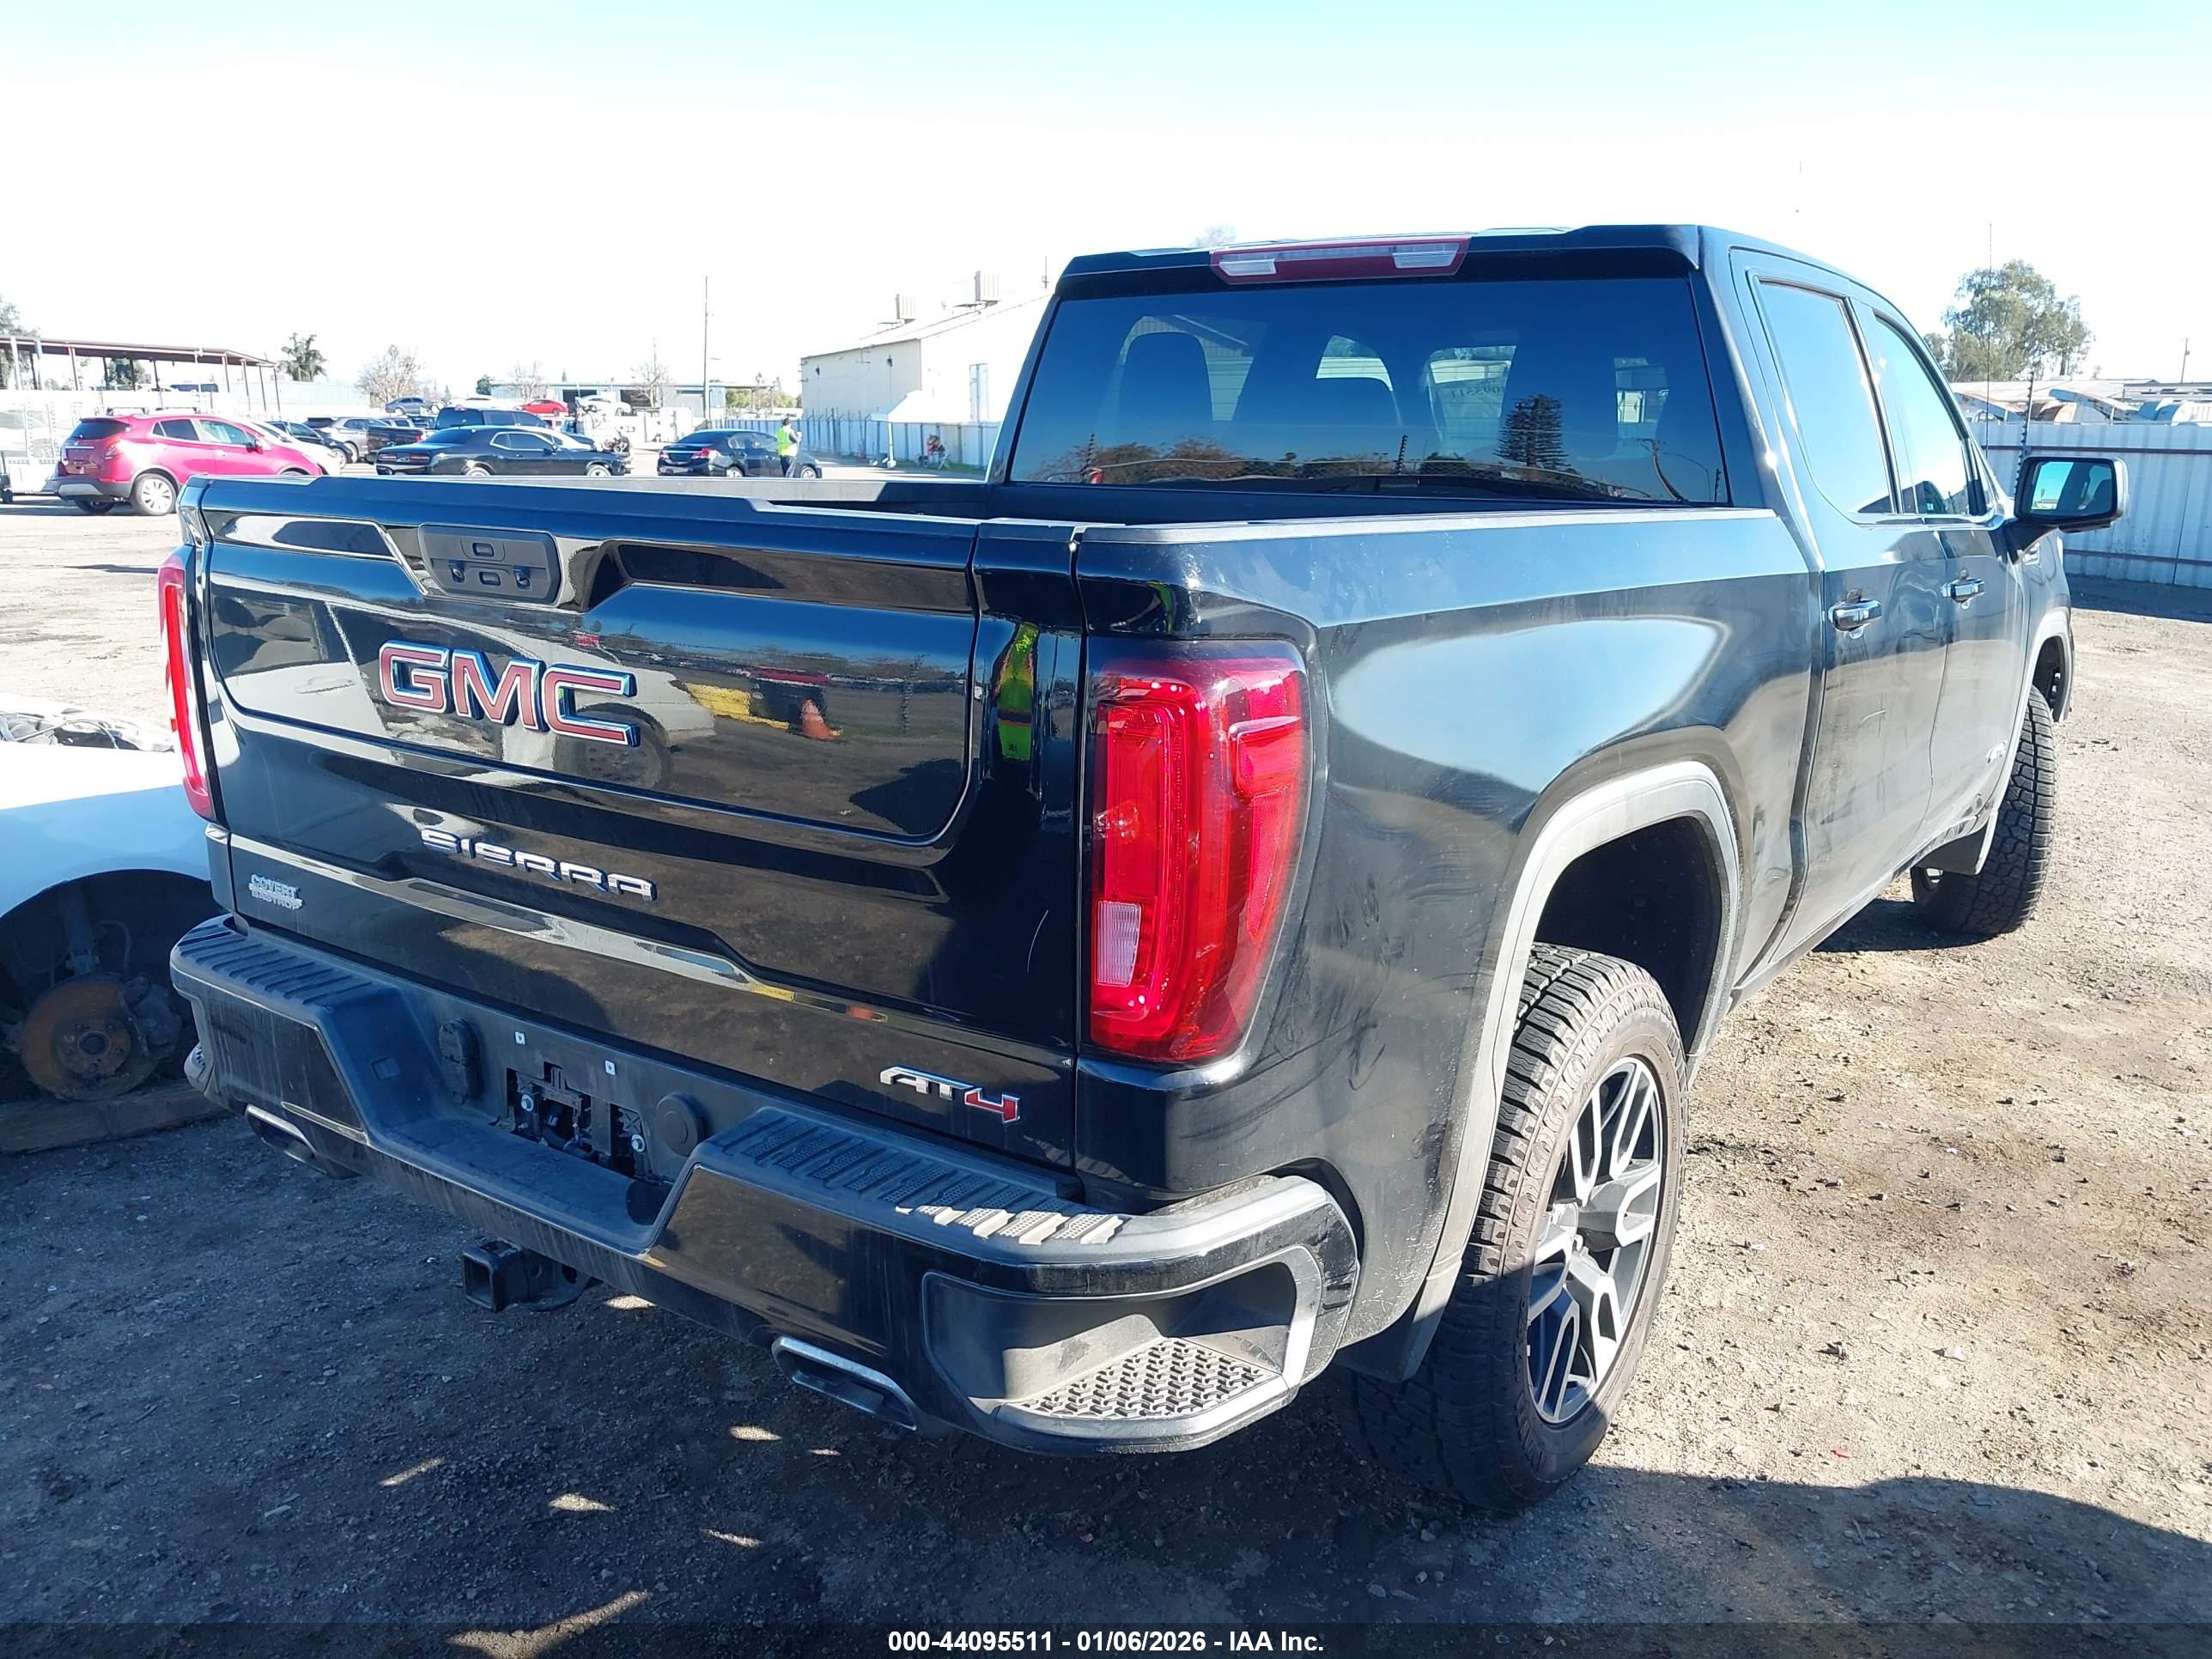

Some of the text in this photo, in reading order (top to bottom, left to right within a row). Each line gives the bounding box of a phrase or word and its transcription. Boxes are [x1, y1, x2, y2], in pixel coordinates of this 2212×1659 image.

[379, 639, 641, 747] GMC
[251, 874, 299, 900] COVERT
[420, 827, 659, 902] SIERRA
[879, 1065, 1021, 1124] AT4
